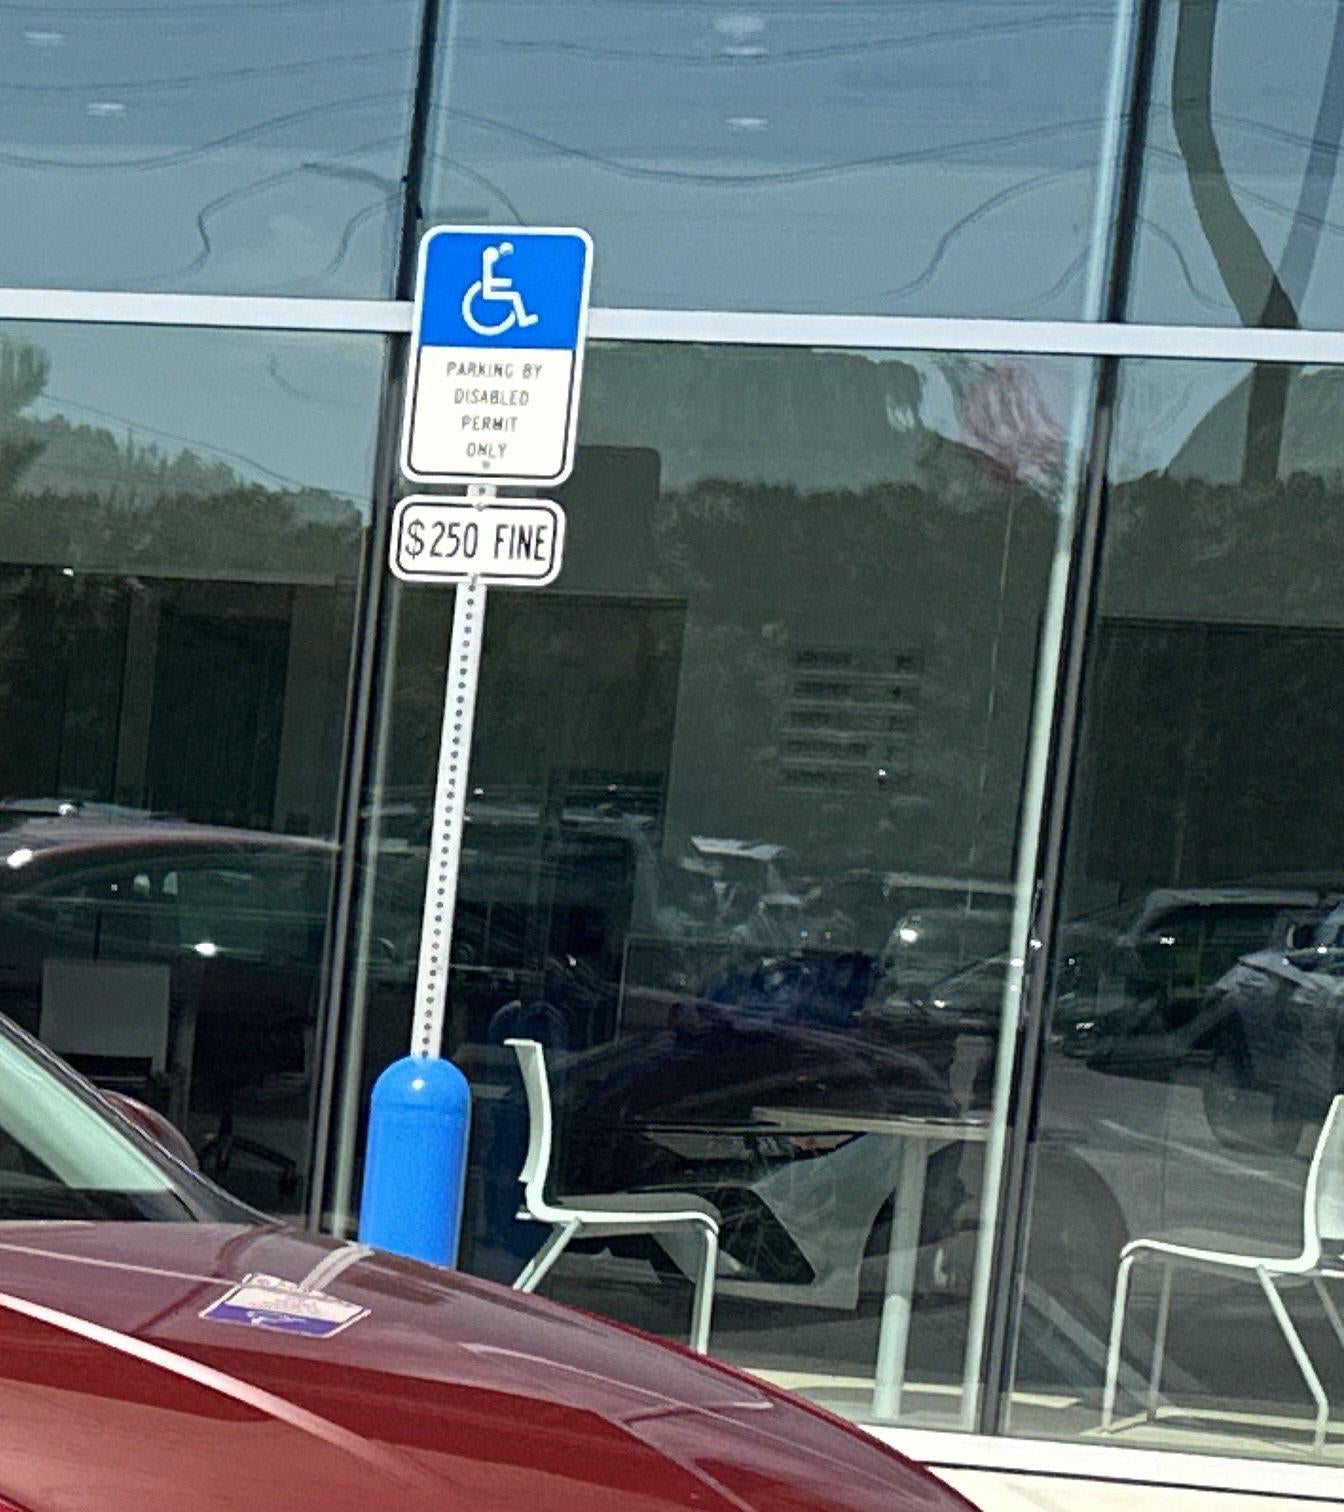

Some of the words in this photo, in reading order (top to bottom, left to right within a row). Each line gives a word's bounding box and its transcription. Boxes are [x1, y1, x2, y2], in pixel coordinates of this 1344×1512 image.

[446, 361, 514, 379] PARKING
[522, 363, 543, 380] BY
[454, 388, 530, 406] DISABLED
[461, 414, 518, 432] PERMIT
[466, 442, 508, 459] ONLY
[406, 519, 478, 559] $250
[494, 525, 548, 560] FINE
